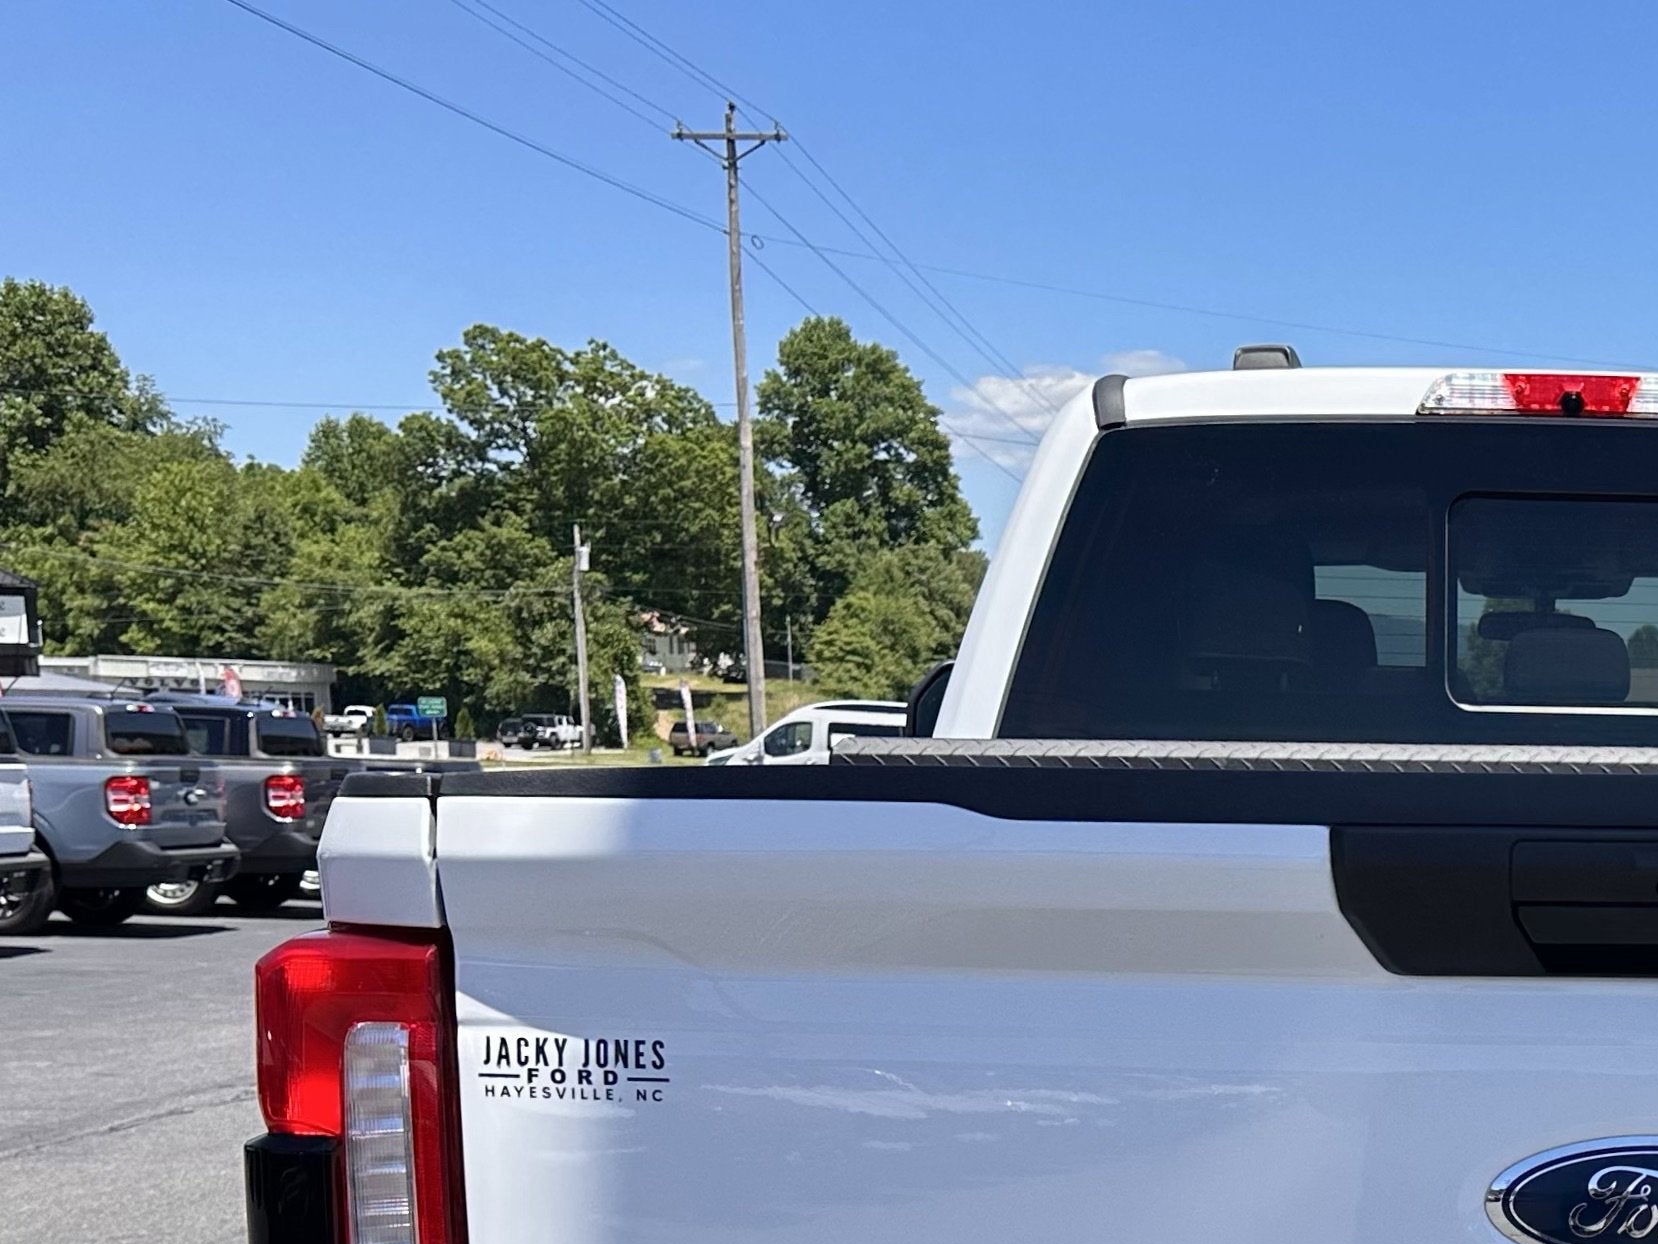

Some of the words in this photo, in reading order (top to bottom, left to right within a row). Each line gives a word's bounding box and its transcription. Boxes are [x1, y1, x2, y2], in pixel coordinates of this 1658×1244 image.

[483, 1036, 568, 1068] JACKY
[582, 1038, 665, 1070] JONES
[527, 1068, 619, 1086] FORD
[484, 1085, 622, 1103] HAYESVILLE,
[636, 1089, 664, 1102] NC
